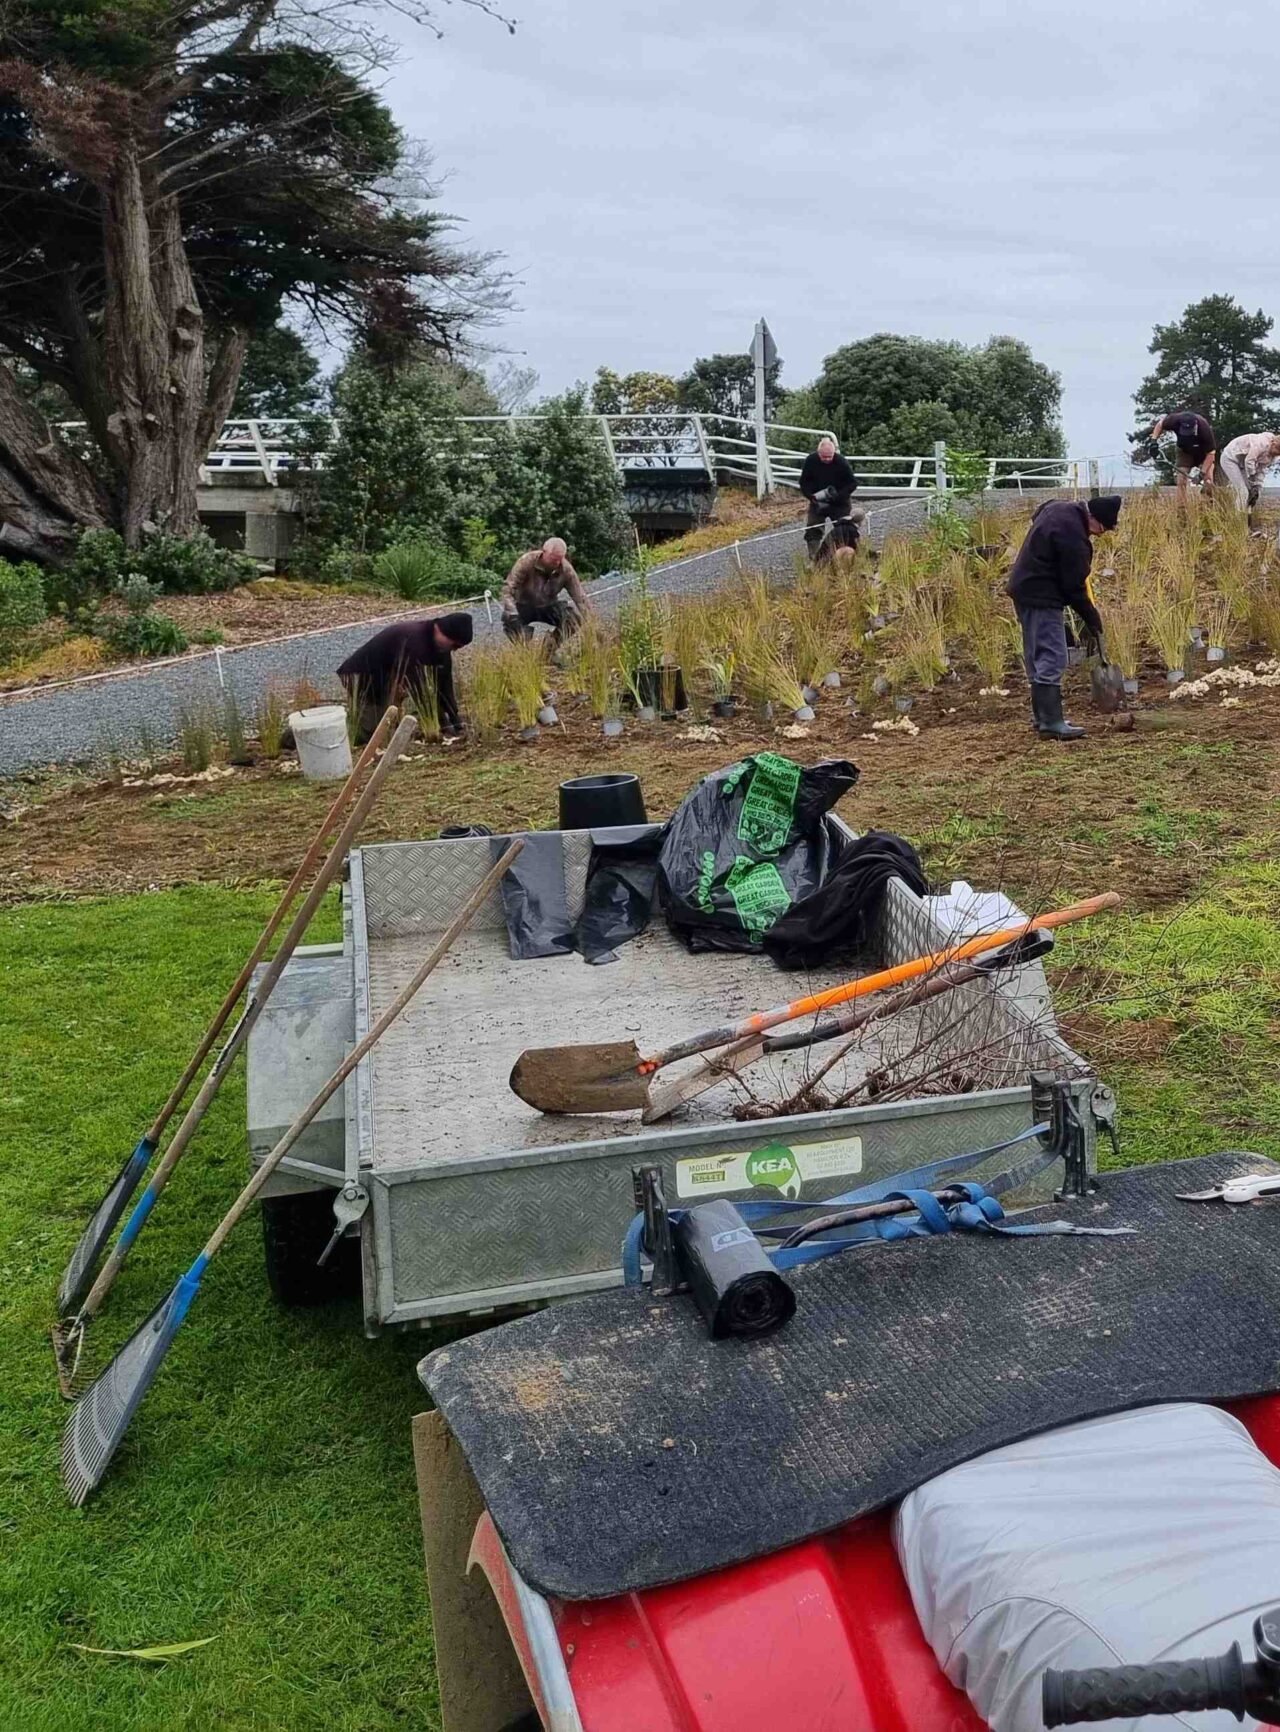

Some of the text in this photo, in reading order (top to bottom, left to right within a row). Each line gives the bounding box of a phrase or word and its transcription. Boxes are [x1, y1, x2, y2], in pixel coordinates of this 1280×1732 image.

[746, 797, 768, 810] GREAT
[733, 882, 754, 894] GREAT
[737, 891, 758, 905] GREAT
[689, 1163, 713, 1173] MODEL
[752, 1157, 793, 1175] KEA
